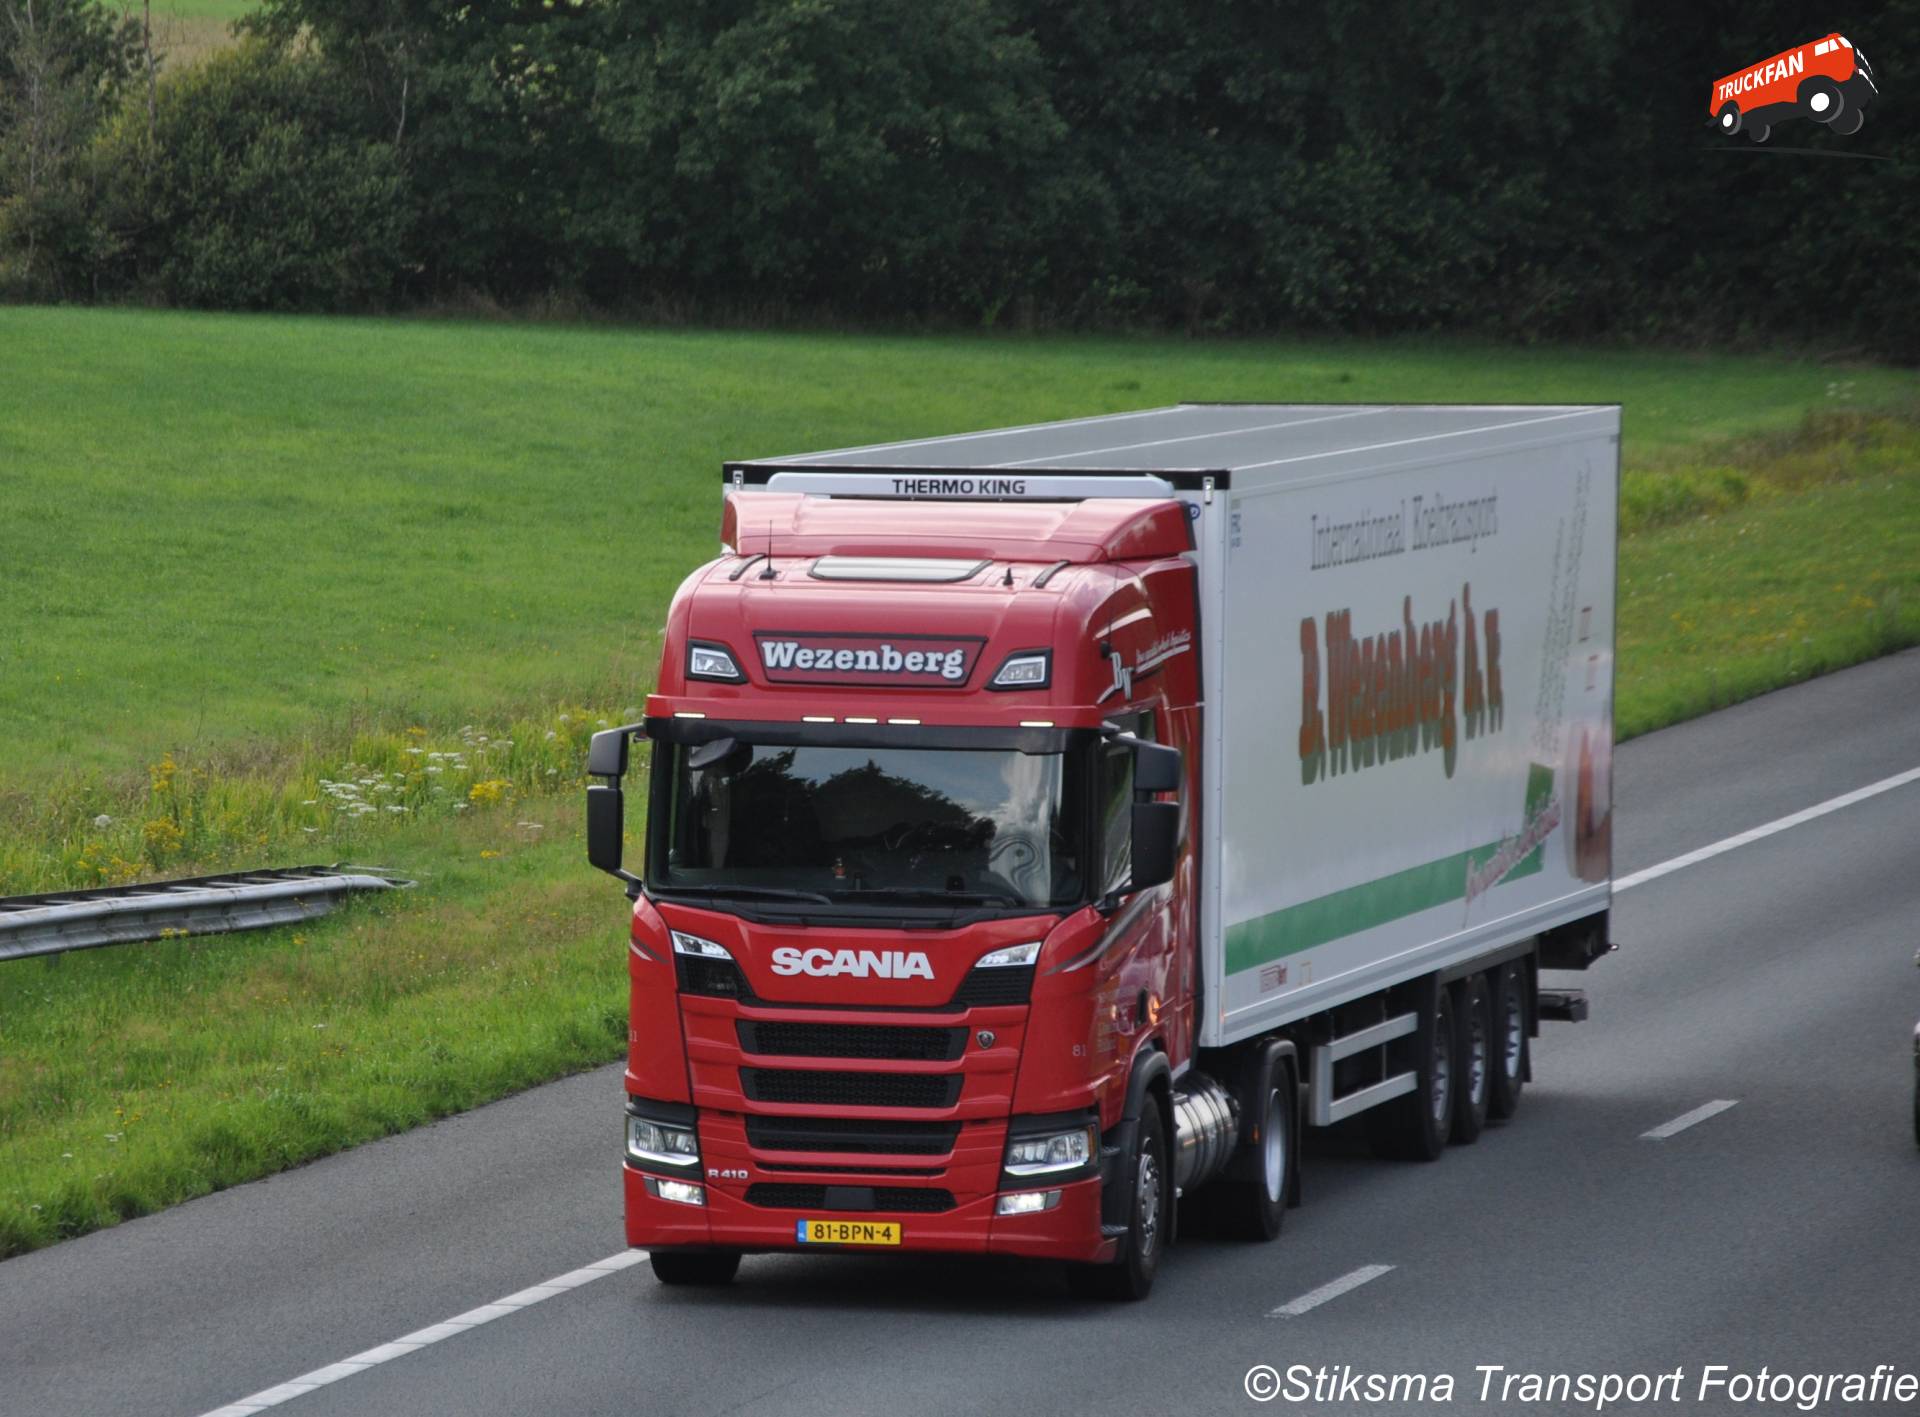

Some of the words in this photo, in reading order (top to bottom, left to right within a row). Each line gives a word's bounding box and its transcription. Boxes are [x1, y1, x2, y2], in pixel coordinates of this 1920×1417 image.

[892, 479, 974, 494] THERMO
[979, 480, 1025, 495] KING
[761, 641, 964, 679] Wezenberg
[771, 947, 934, 979] SCANIA
[707, 1168, 719, 1179] R
[721, 1168, 748, 1180] 410
[814, 1223, 893, 1242] 81-BPN-4
